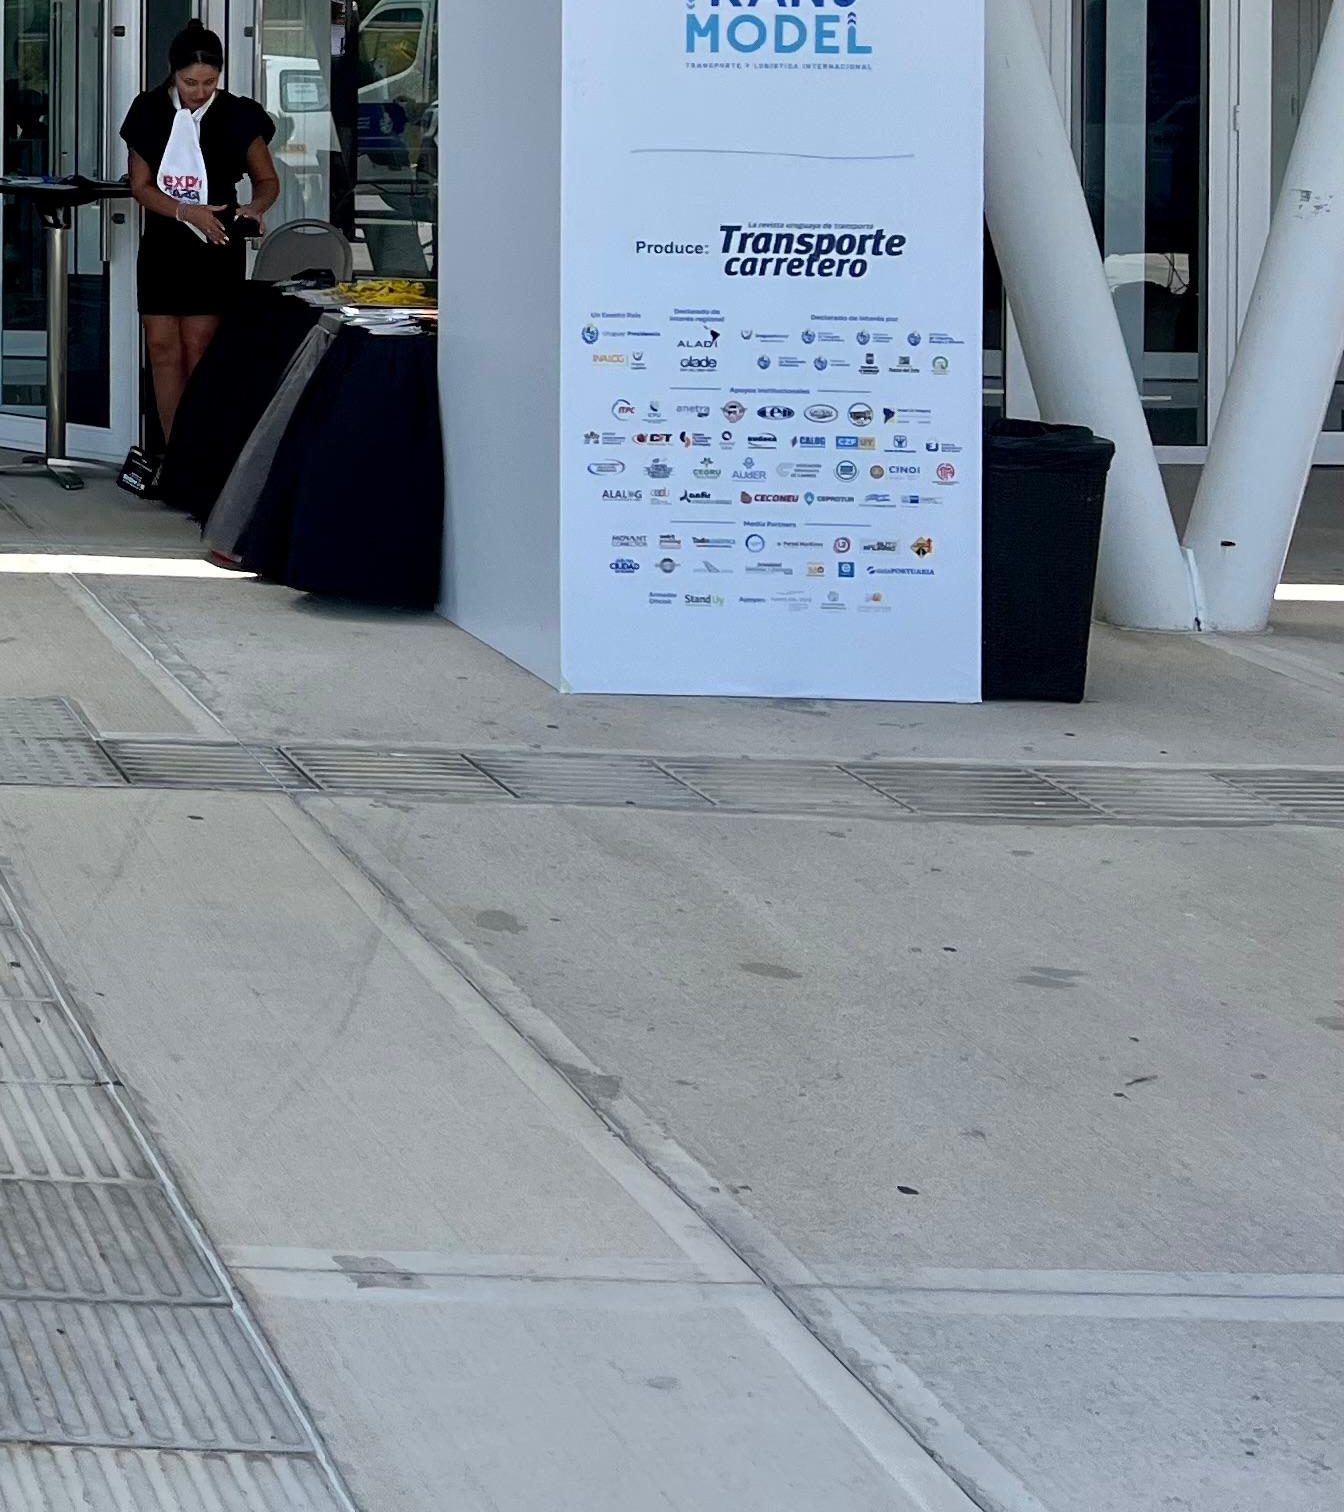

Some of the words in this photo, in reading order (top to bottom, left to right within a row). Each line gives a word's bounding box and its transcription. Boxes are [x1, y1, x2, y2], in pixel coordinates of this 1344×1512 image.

[685, 13, 873, 54] MODEL
[635, 241, 710, 255] Produce:
[720, 224, 906, 261] Transporte
[724, 255, 868, 277] carretero
